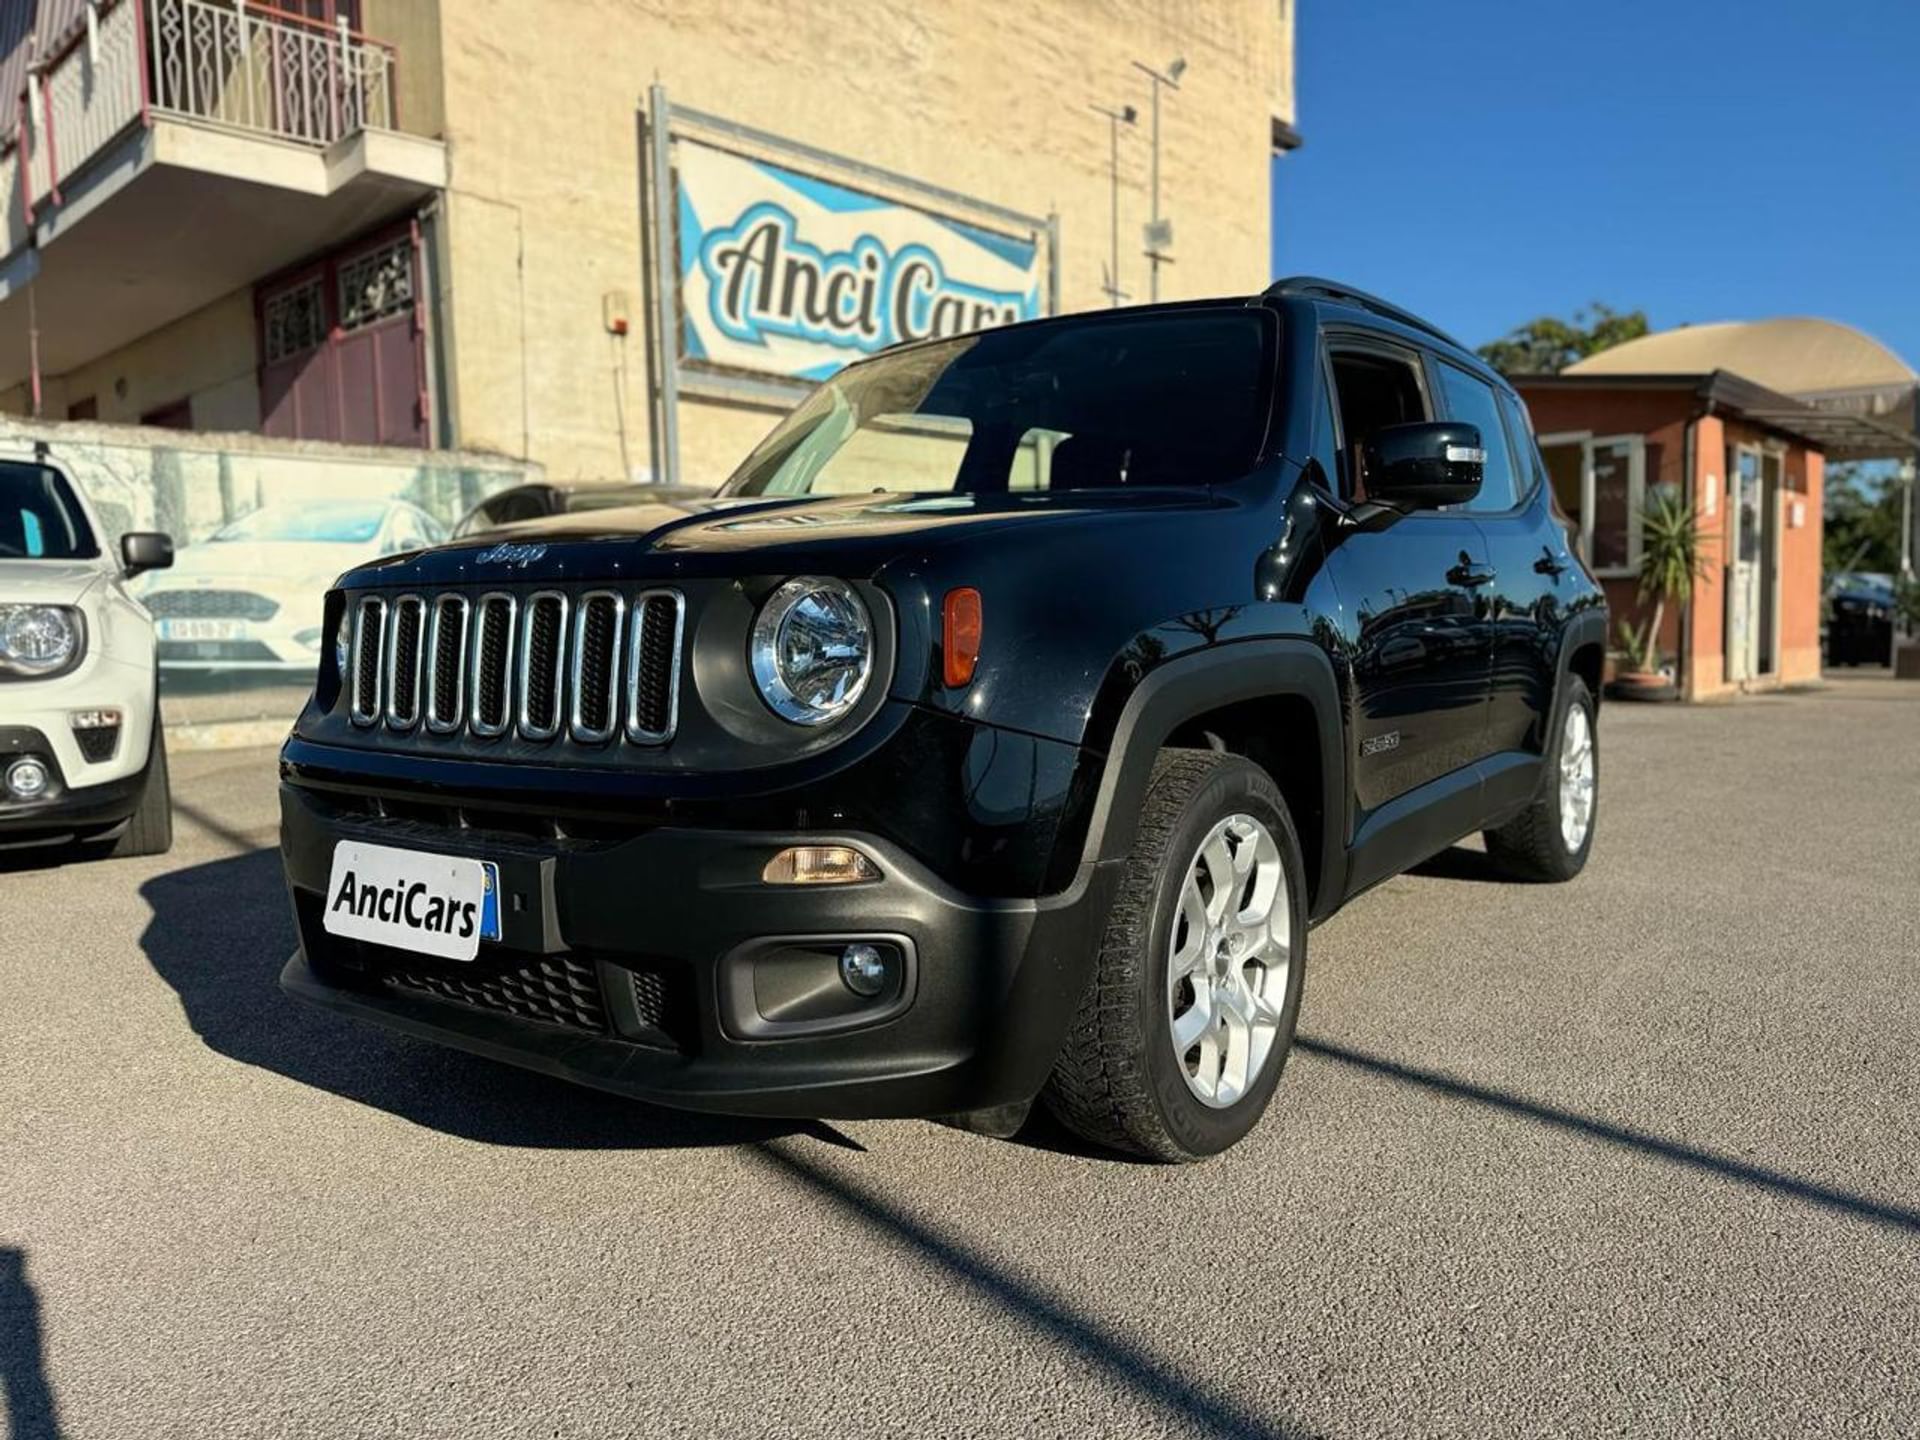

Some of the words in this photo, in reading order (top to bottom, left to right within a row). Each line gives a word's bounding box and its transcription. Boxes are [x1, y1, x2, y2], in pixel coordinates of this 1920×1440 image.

[717, 222, 876, 336] Anci
[896, 262, 1014, 341] Car
[475, 542, 548, 568] Jeep
[331, 870, 476, 939] AnciCars
